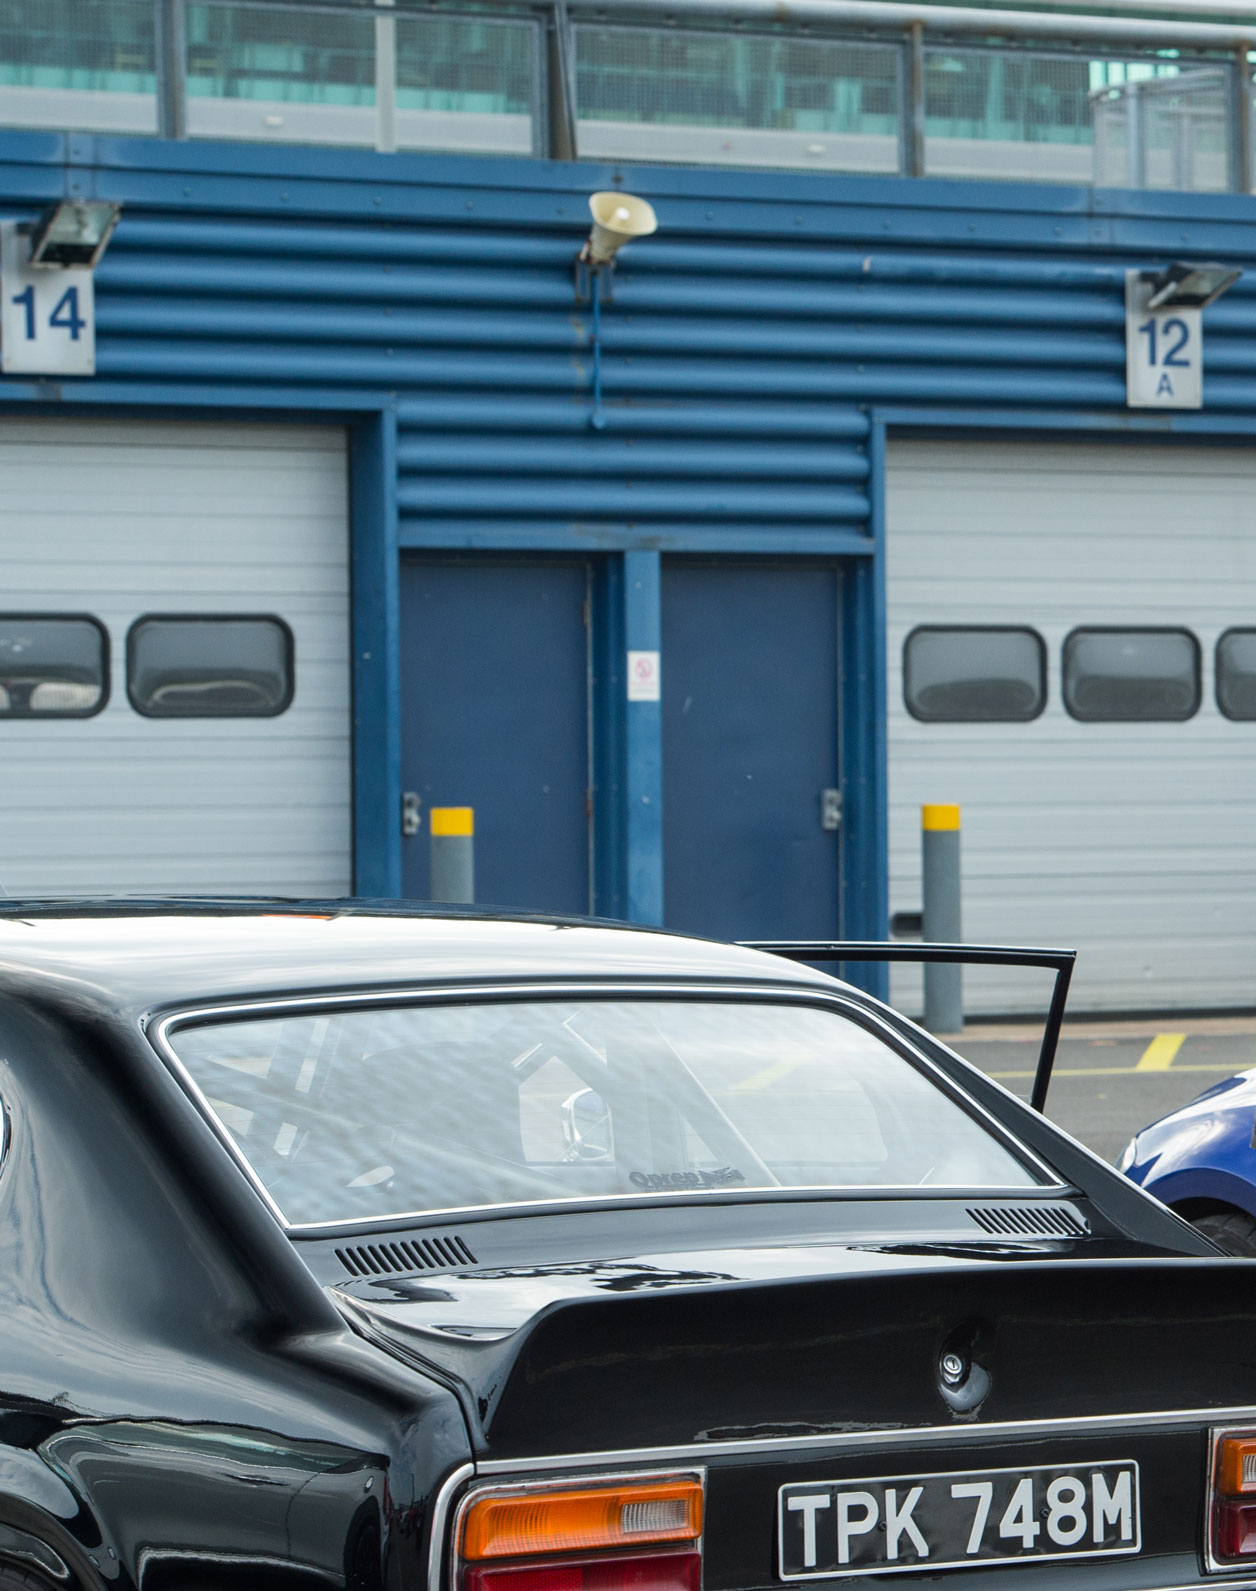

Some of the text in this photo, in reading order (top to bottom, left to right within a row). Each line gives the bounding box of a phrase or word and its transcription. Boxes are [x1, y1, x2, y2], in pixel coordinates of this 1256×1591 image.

[12, 284, 86, 341] 14
[1138, 317, 1190, 366] 12
[1156, 372, 1174, 397] A
[787, 1471, 1133, 1567] TPK 748M
